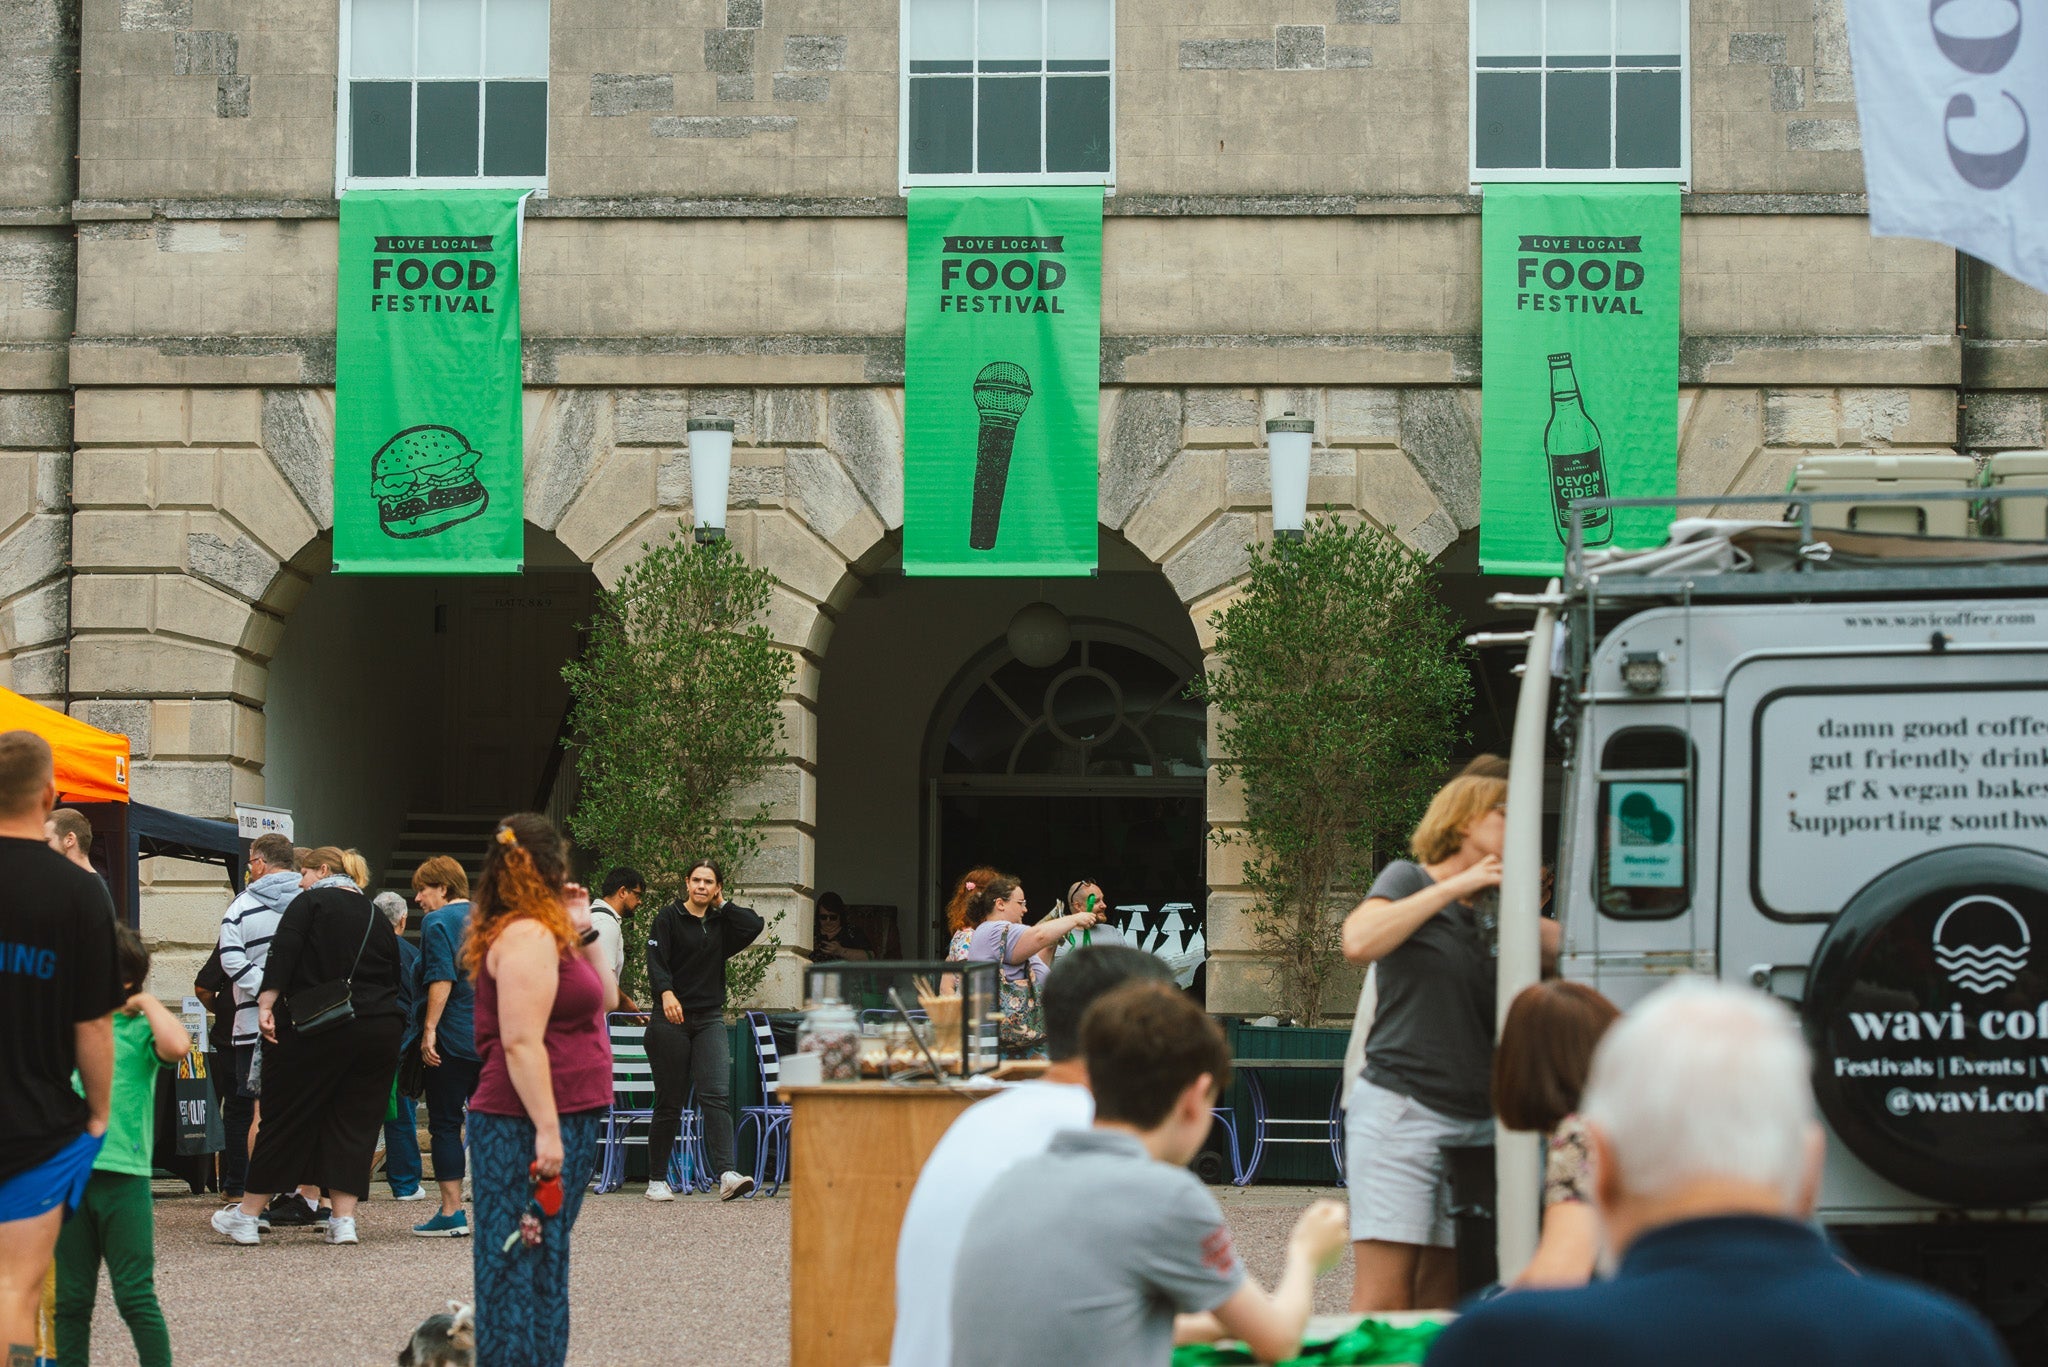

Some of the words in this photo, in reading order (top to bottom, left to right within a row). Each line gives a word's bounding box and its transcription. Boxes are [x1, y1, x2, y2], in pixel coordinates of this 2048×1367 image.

[1930, 0, 2030, 191] co
[388, 239, 425, 249] LOVE
[431, 239, 479, 249] LOCAL
[957, 239, 994, 249] LOVE
[1001, 239, 1048, 249] LOCAL
[1533, 239, 1570, 249] LOVE
[1578, 239, 1626, 250] LOCAL
[373, 258, 497, 291] FOOD
[941, 258, 1067, 291] FOOD
[1518, 257, 1645, 292] FOOD
[371, 294, 495, 314] FESTIVAL
[940, 295, 1065, 314] FESTIVAL
[1517, 293, 1643, 315] FESTIVAL
[1556, 470, 1600, 487] DEVON
[1560, 483, 1600, 499] CIDER
[1817, 717, 1894, 738] damn
[1902, 716, 1968, 742] good
[1976, 715, 2048, 737] coffe
[1809, 751, 1853, 774] gut
[1864, 748, 1973, 774] friendly
[1825, 779, 1856, 805] gf
[1862, 779, 1878, 800] &
[1888, 784, 1968, 805] vegan
[0, 942, 57, 979] ING
[1848, 1001, 1966, 1041] wavi
[1834, 1056, 1935, 1077] Festivals
[1949, 1055, 2026, 1076] Events
